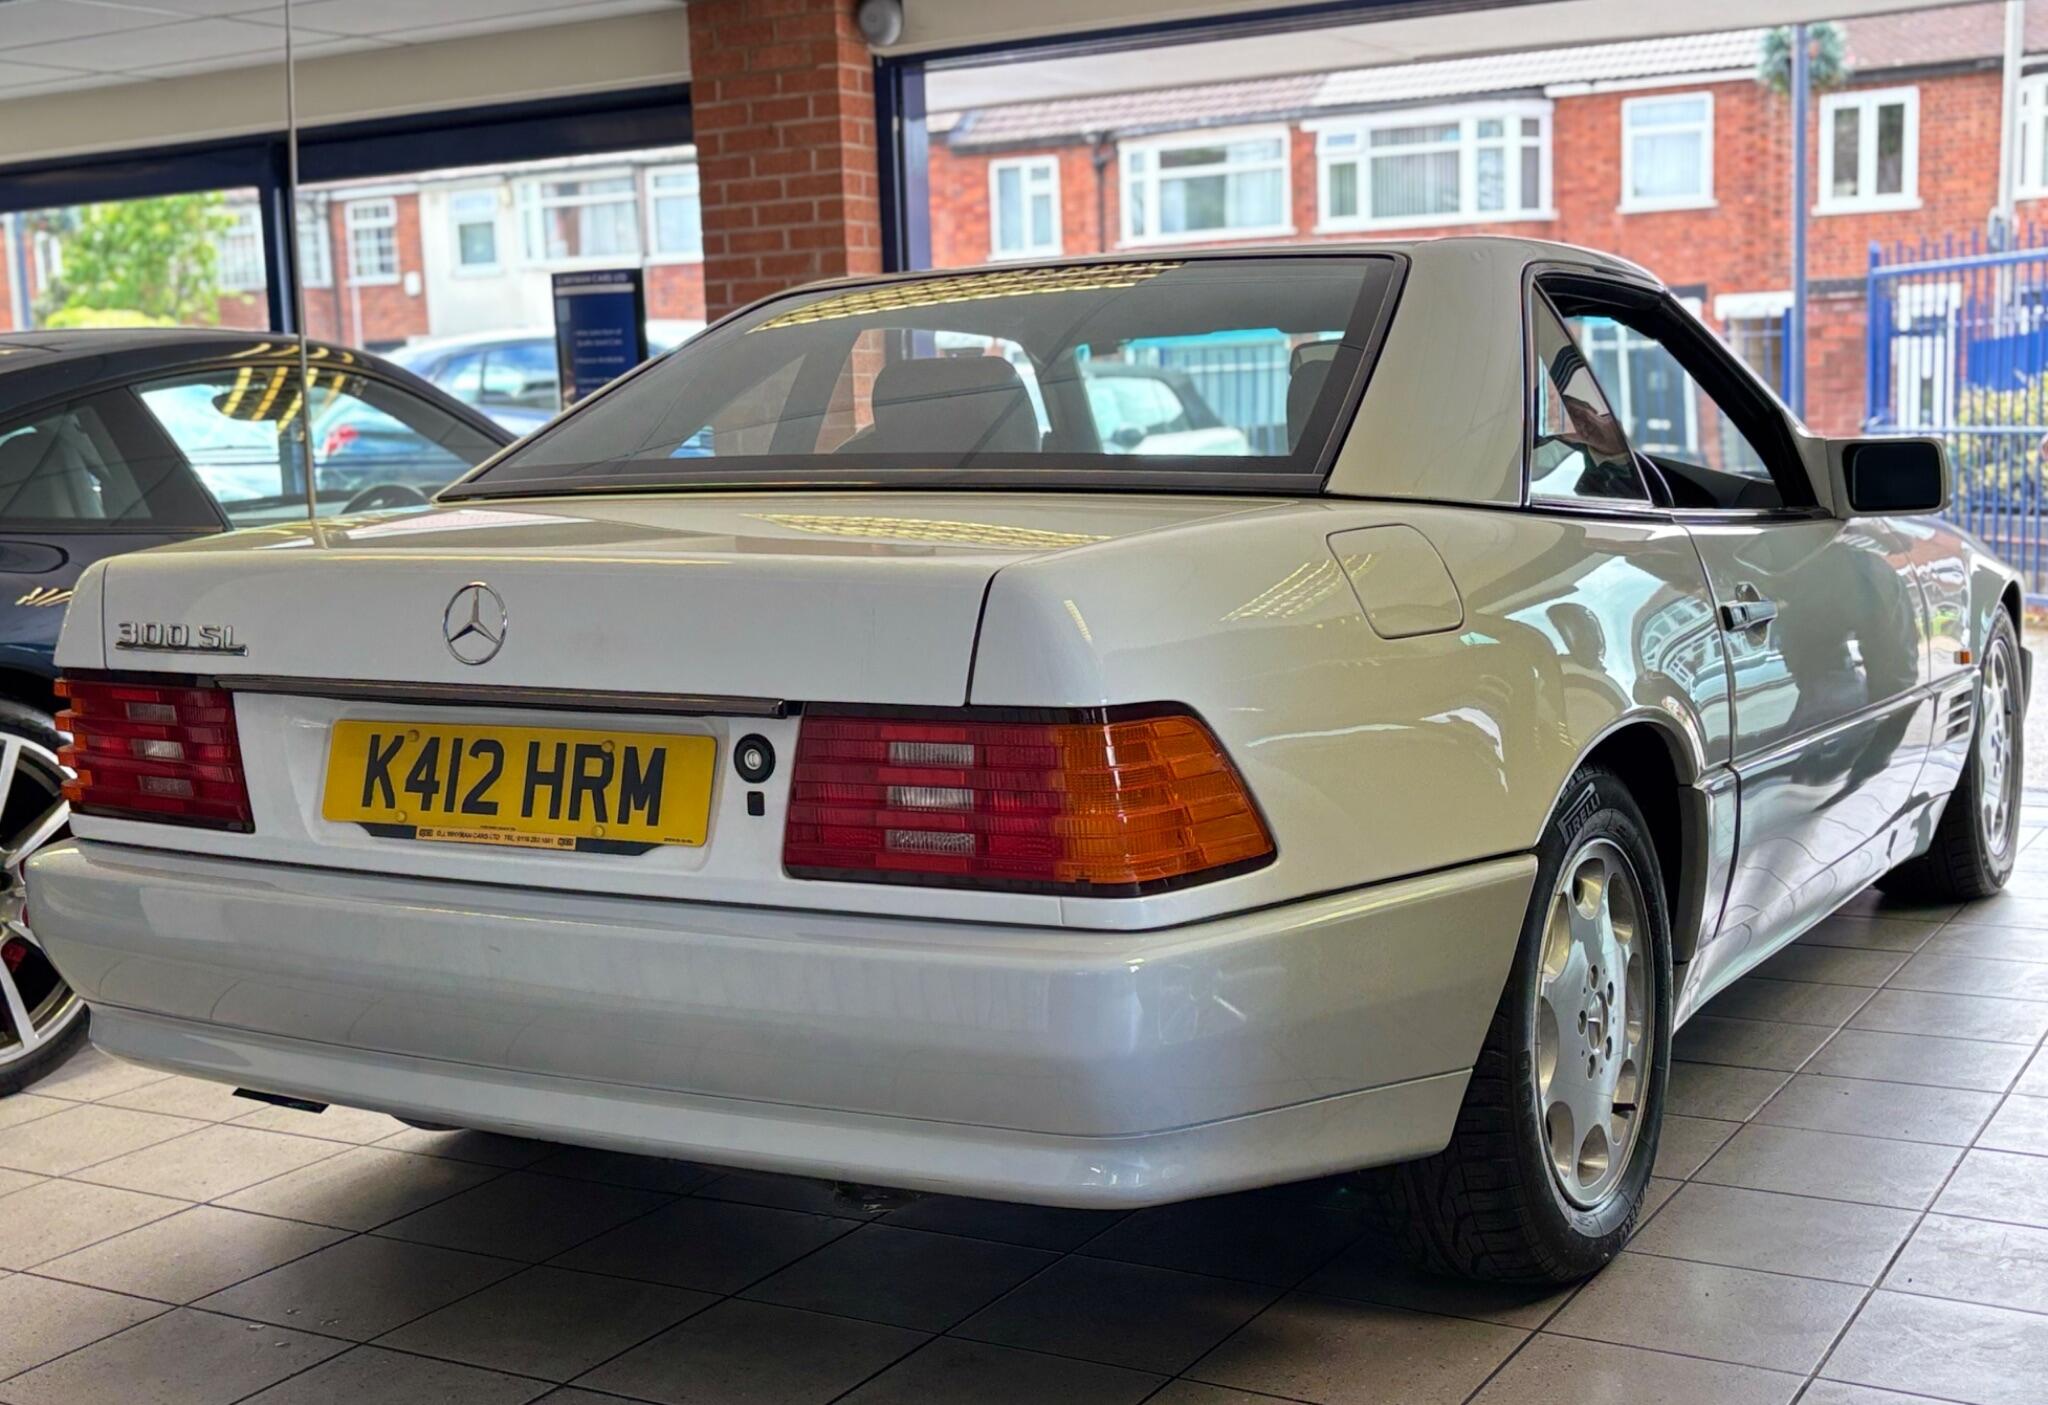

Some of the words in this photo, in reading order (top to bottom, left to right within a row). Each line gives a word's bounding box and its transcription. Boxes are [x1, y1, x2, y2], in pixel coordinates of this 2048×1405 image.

[118, 622, 189, 647] 300
[199, 625, 247, 649] SL
[361, 734, 505, 815] K412
[521, 741, 667, 827] HRM
[1556, 782, 1601, 846] PIRELLI
